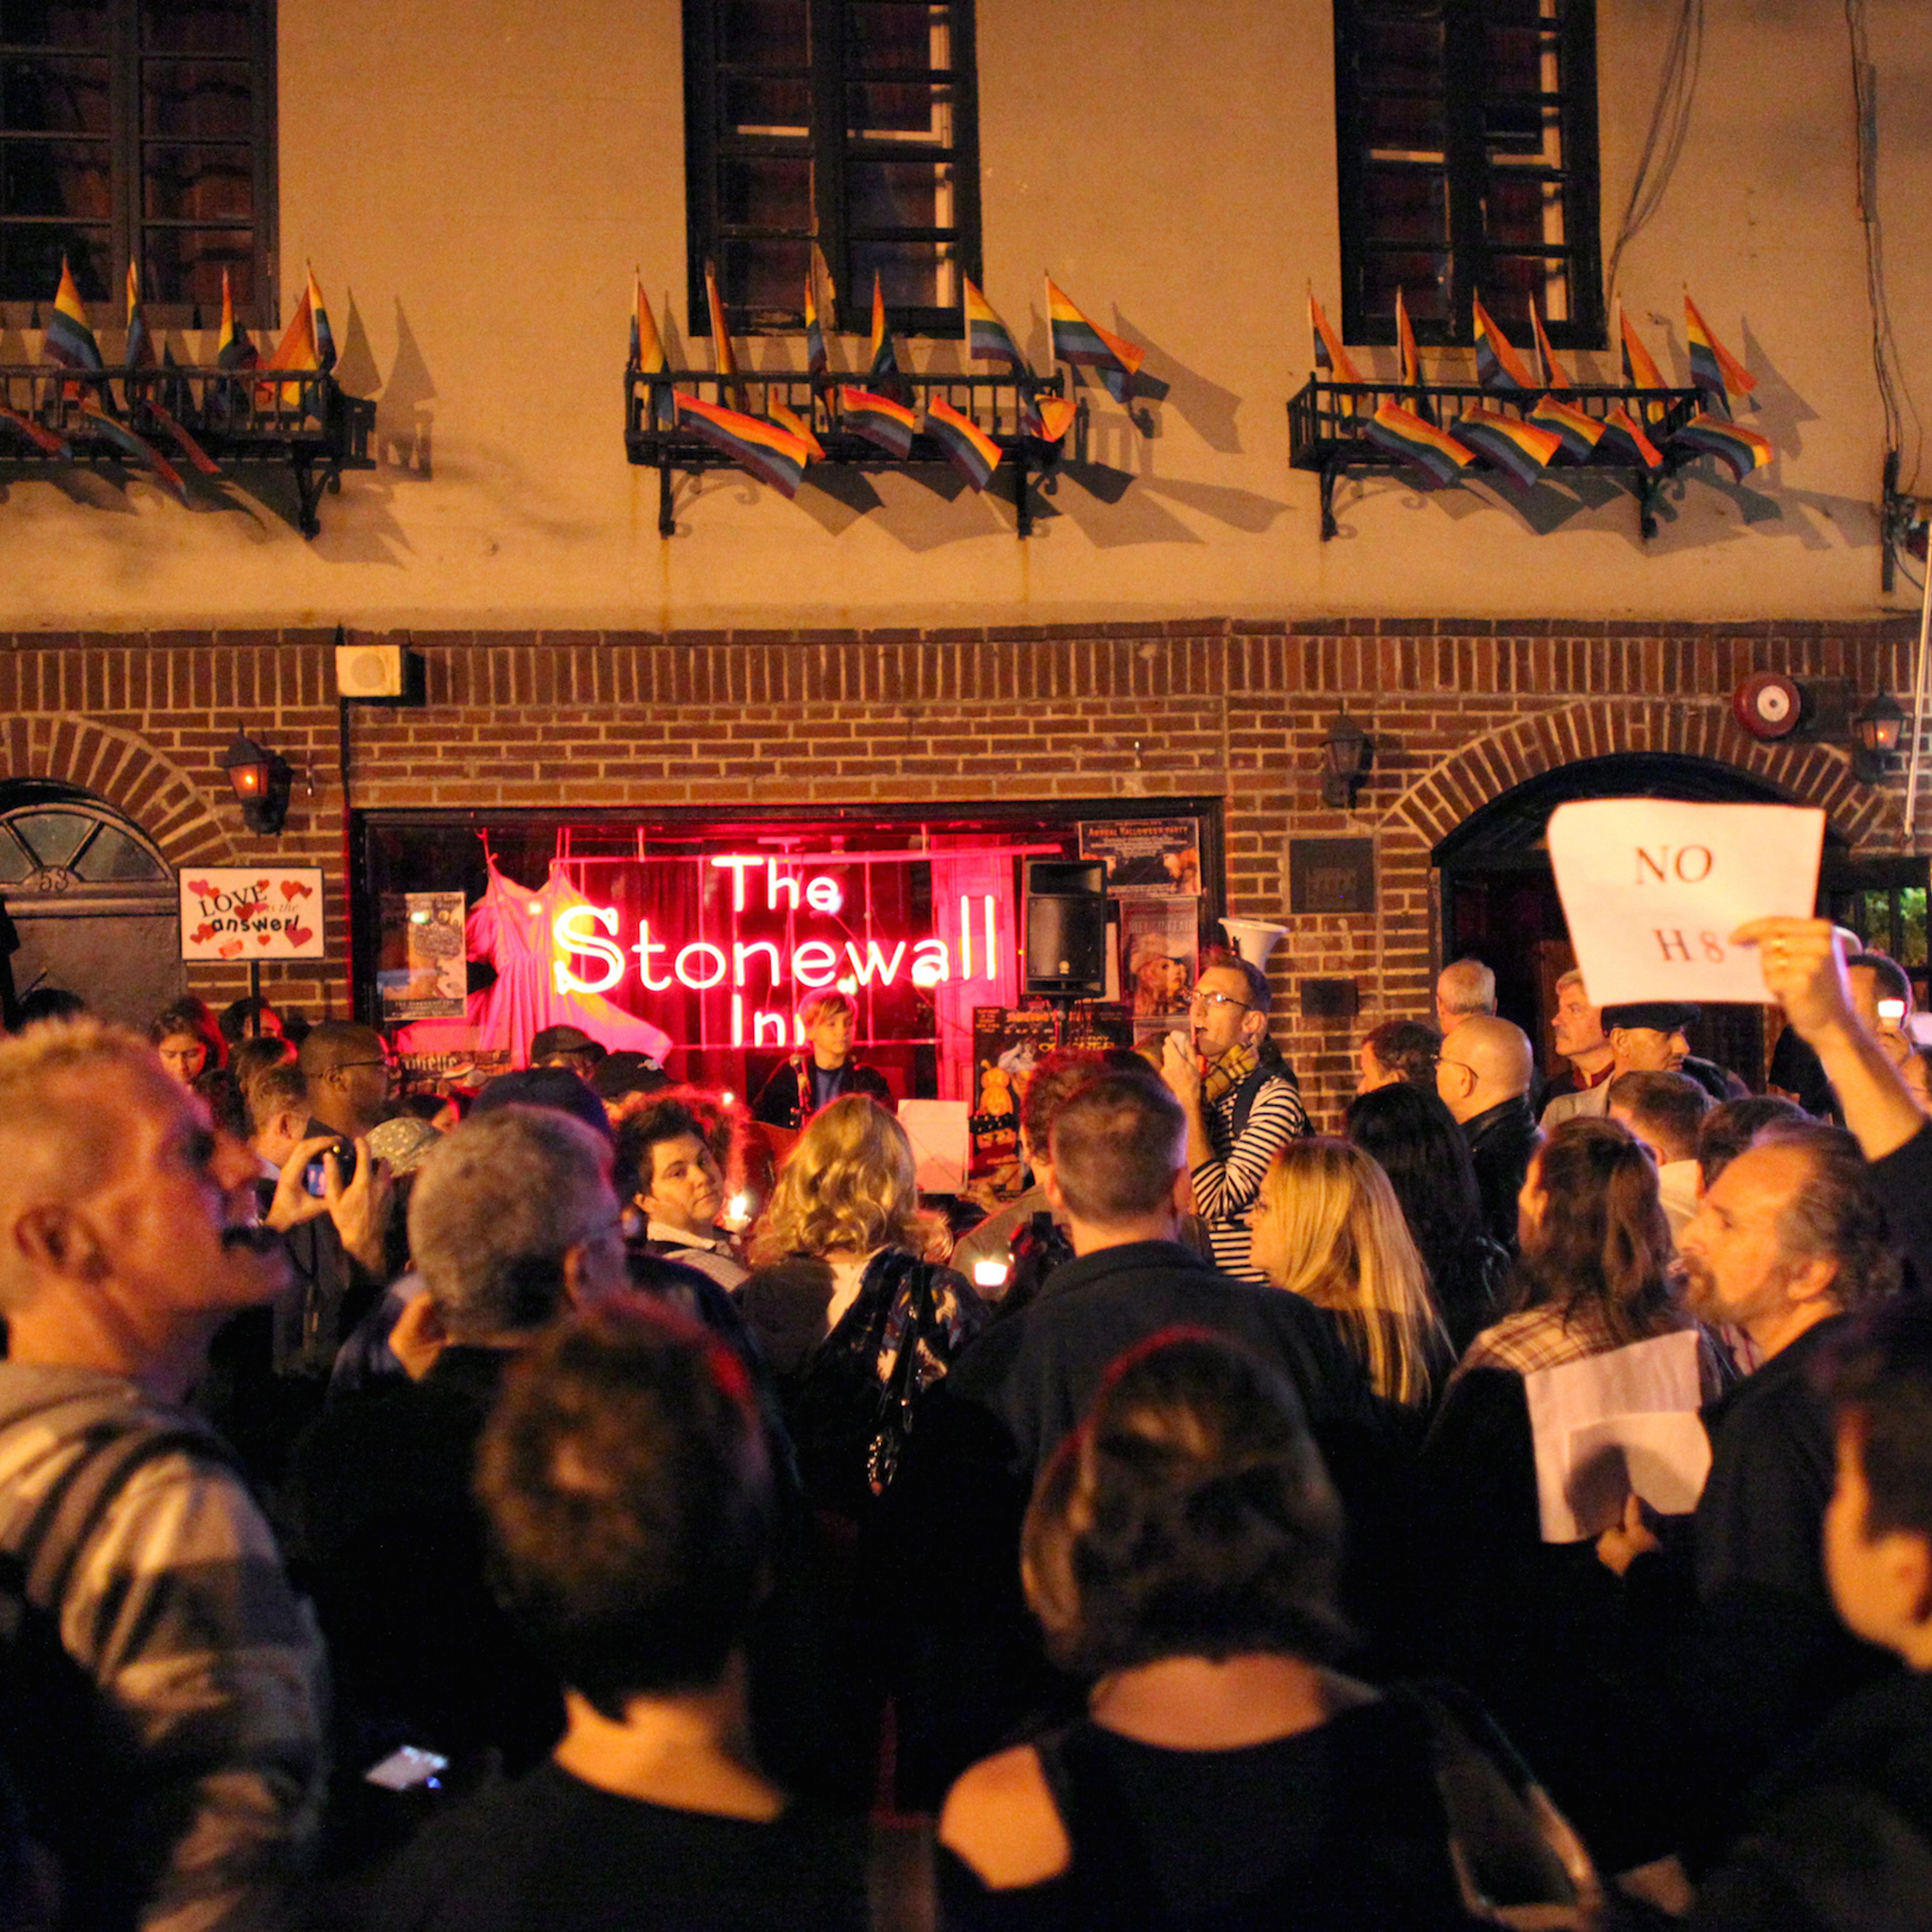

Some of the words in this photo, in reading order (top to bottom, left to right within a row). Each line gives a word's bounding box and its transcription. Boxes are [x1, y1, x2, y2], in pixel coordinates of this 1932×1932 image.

[710, 854, 840, 913] The
[1635, 844, 1714, 885] NO
[199, 883, 268, 918] LOVE
[279, 904, 299, 913] the
[211, 914, 299, 932] answer!
[553, 894, 996, 995] Stonewall
